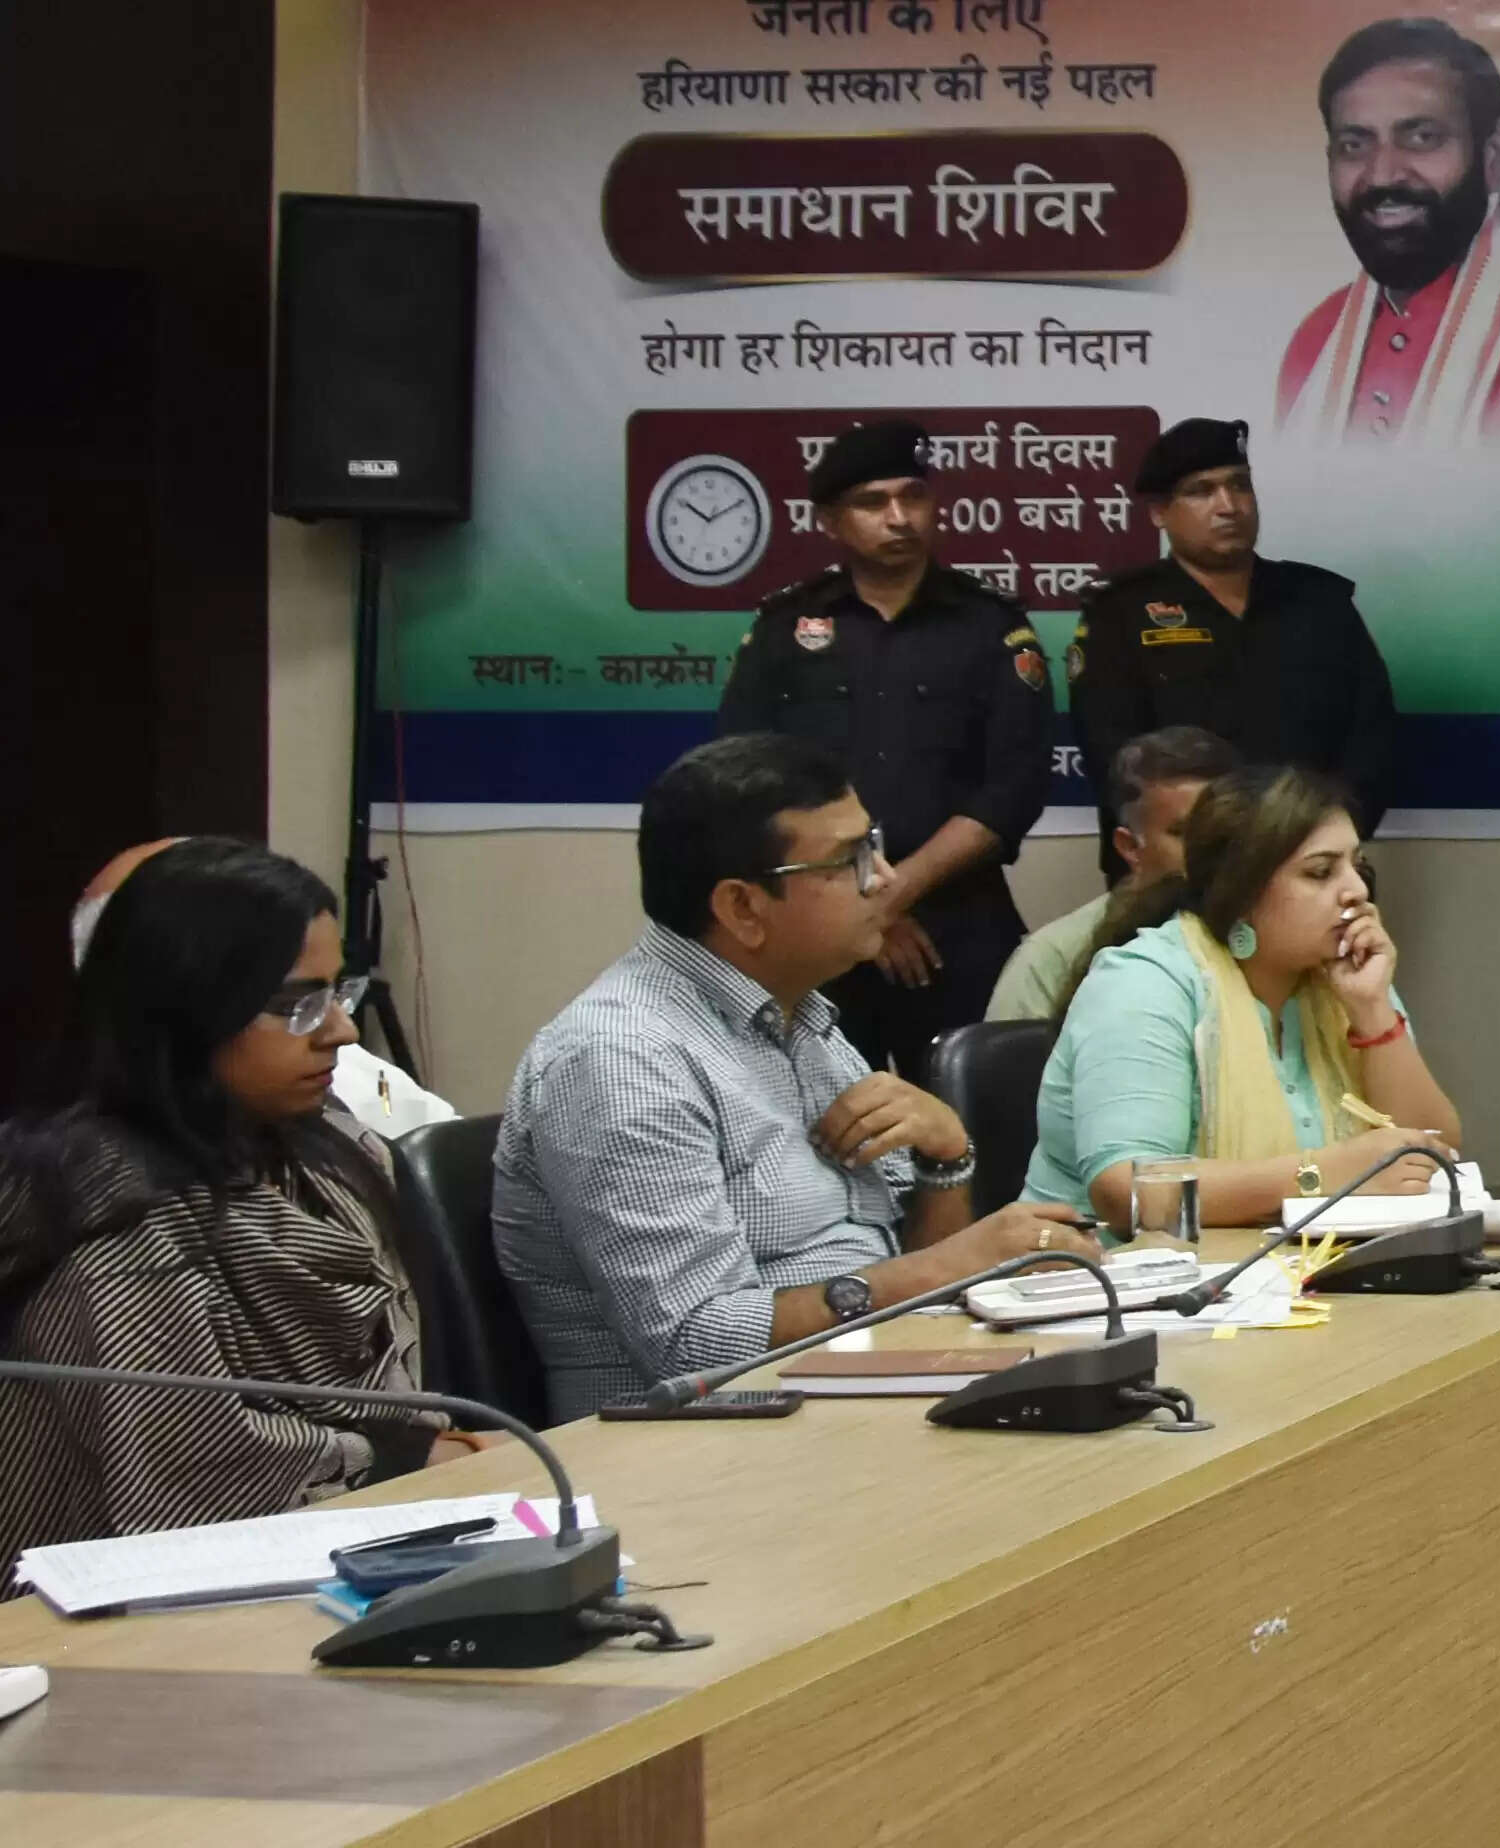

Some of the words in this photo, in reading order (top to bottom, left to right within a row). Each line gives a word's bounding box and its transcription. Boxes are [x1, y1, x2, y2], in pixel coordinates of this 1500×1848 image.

[637, 59, 790, 110] हरियाणा
[800, 66, 926, 106] सरकार
[929, 54, 987, 102] की
[998, 51, 1053, 109] नई
[1065, 63, 1157, 101] पहल
[677, 185, 913, 244] समाधान
[929, 162, 1116, 243] शिविर
[640, 319, 724, 374] होगा
[736, 333, 783, 375] हर
[791, 319, 955, 370] शिकायत
[965, 329, 1024, 368] का
[1036, 316, 1152, 367] निदान
[1010, 421, 1118, 474] दिवस
[1013, 483, 1084, 532] बजे
[1094, 483, 1133, 533] से
